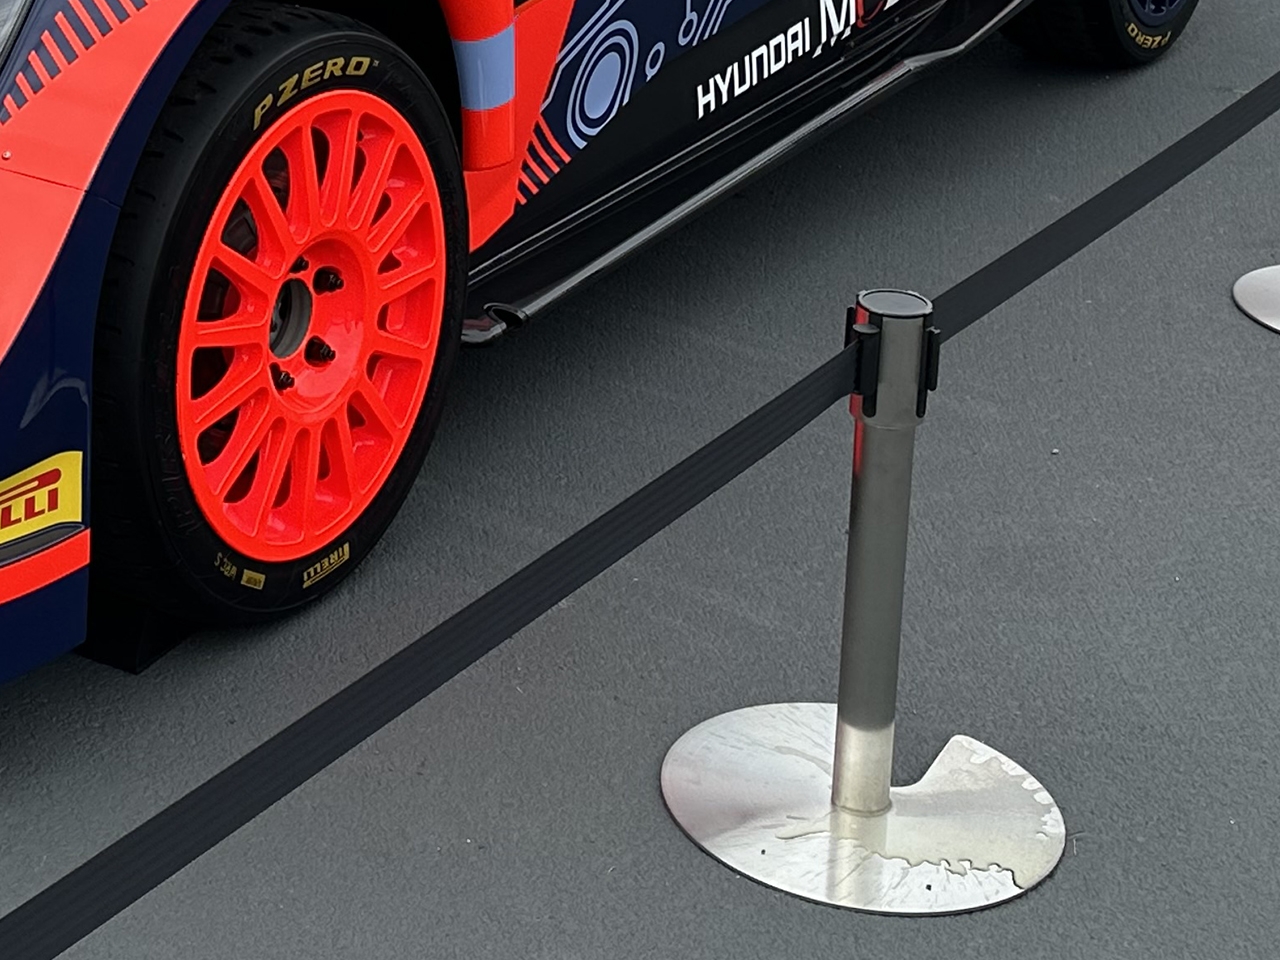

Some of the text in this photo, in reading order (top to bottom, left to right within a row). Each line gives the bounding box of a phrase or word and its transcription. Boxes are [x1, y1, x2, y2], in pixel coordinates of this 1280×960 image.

[276, 56, 372, 107] ZERO
[696, 16, 811, 121] HYUNDAI
[302, 541, 351, 589] PIRELLI
